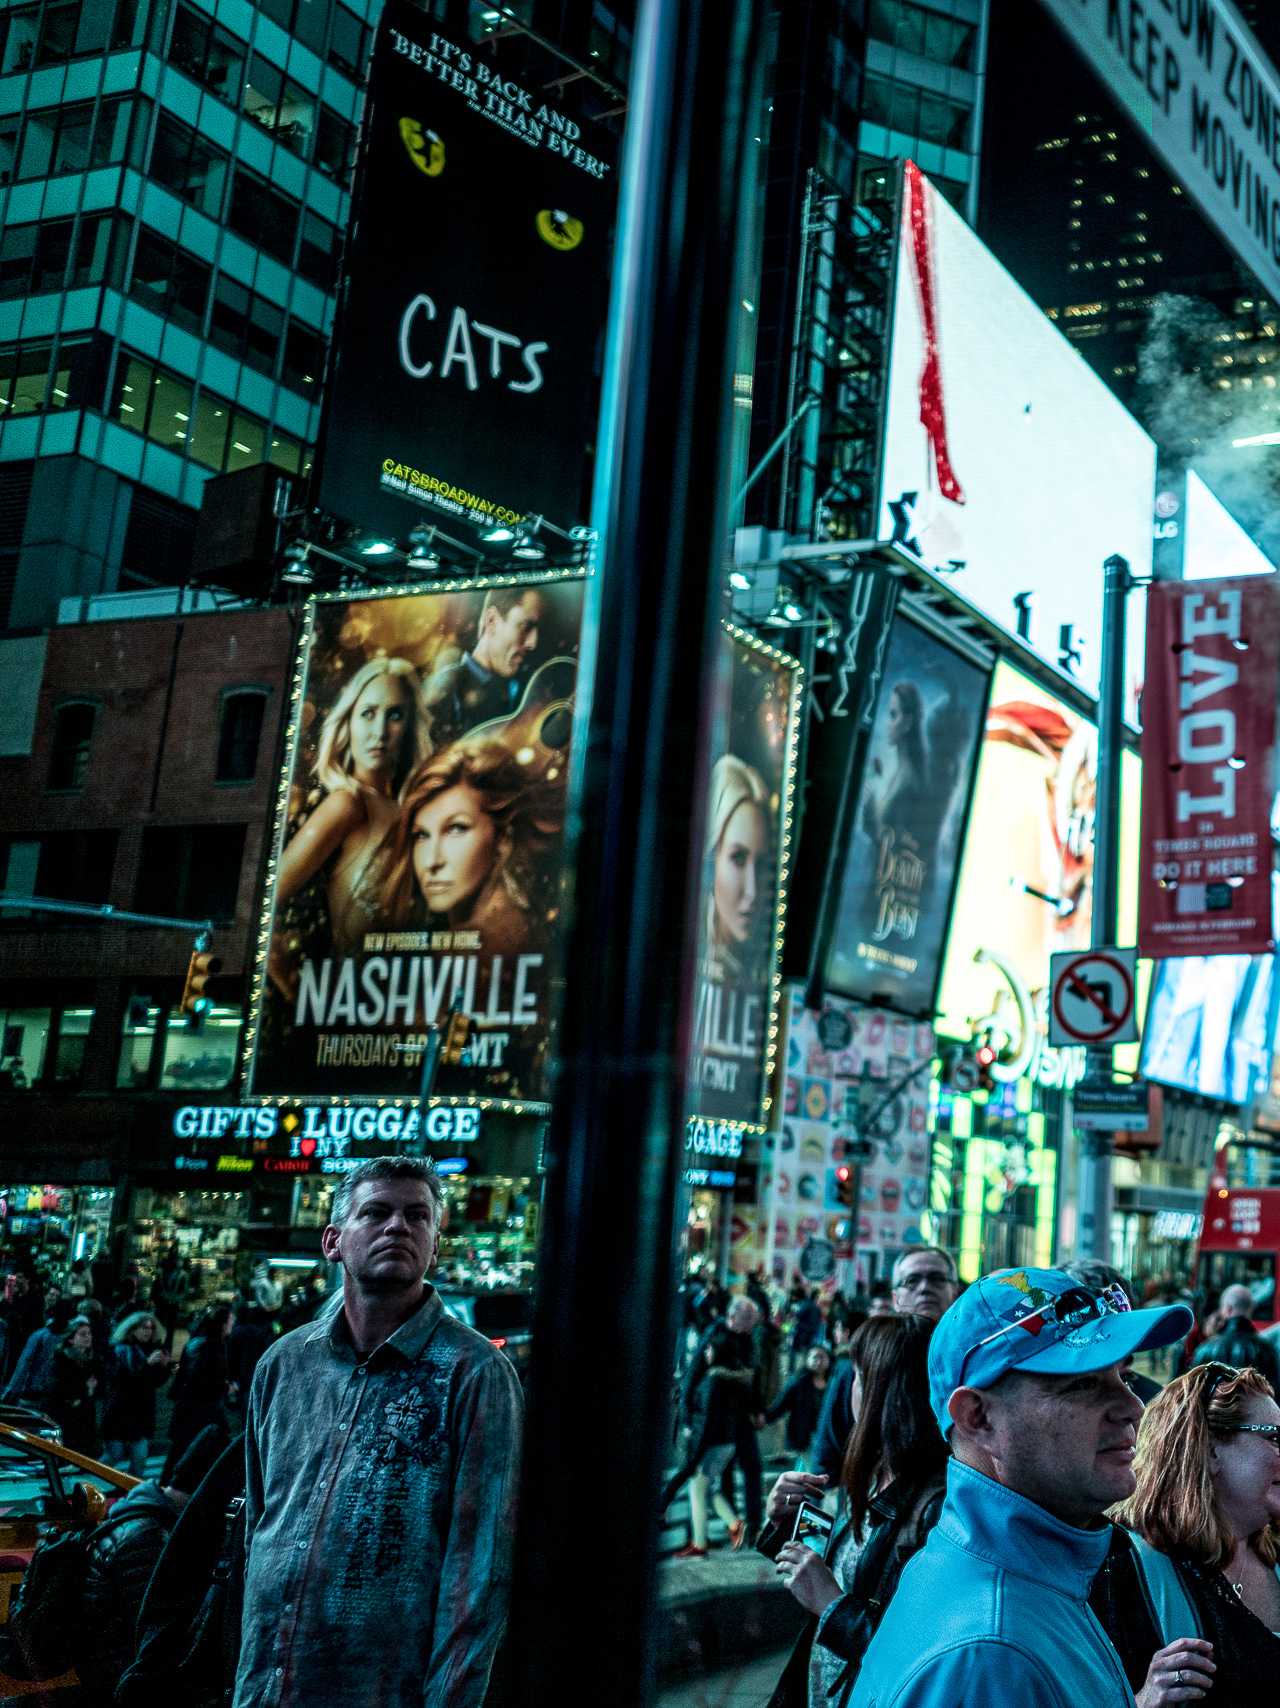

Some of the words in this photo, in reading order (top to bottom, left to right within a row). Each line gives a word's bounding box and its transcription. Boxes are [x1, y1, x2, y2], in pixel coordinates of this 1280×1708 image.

[1106, 0, 1182, 118] KEEP
[430, 32, 473, 72] IT'S
[475, 62, 533, 112] BACK
[534, 104, 581, 141] AND
[483, 89, 544, 141] THAN
[398, 292, 549, 395] CATS
[408, 483, 433, 502] Simon
[1177, 589, 1243, 823] LOVE
[1153, 861, 1181, 880] DO
[1183, 859, 1202, 879] IT
[1205, 855, 1257, 877] HERE
[295, 953, 543, 1027] NASHVILLE
[316, 1034, 399, 1067] THURSDAYS
[173, 1106, 279, 1138] GIFTS
[302, 1107, 481, 1141] LUGGAGE
[216, 1155, 255, 1172] Nikon
[263, 1155, 312, 1172] Canon
[315, 1137, 351, 1157] NY
